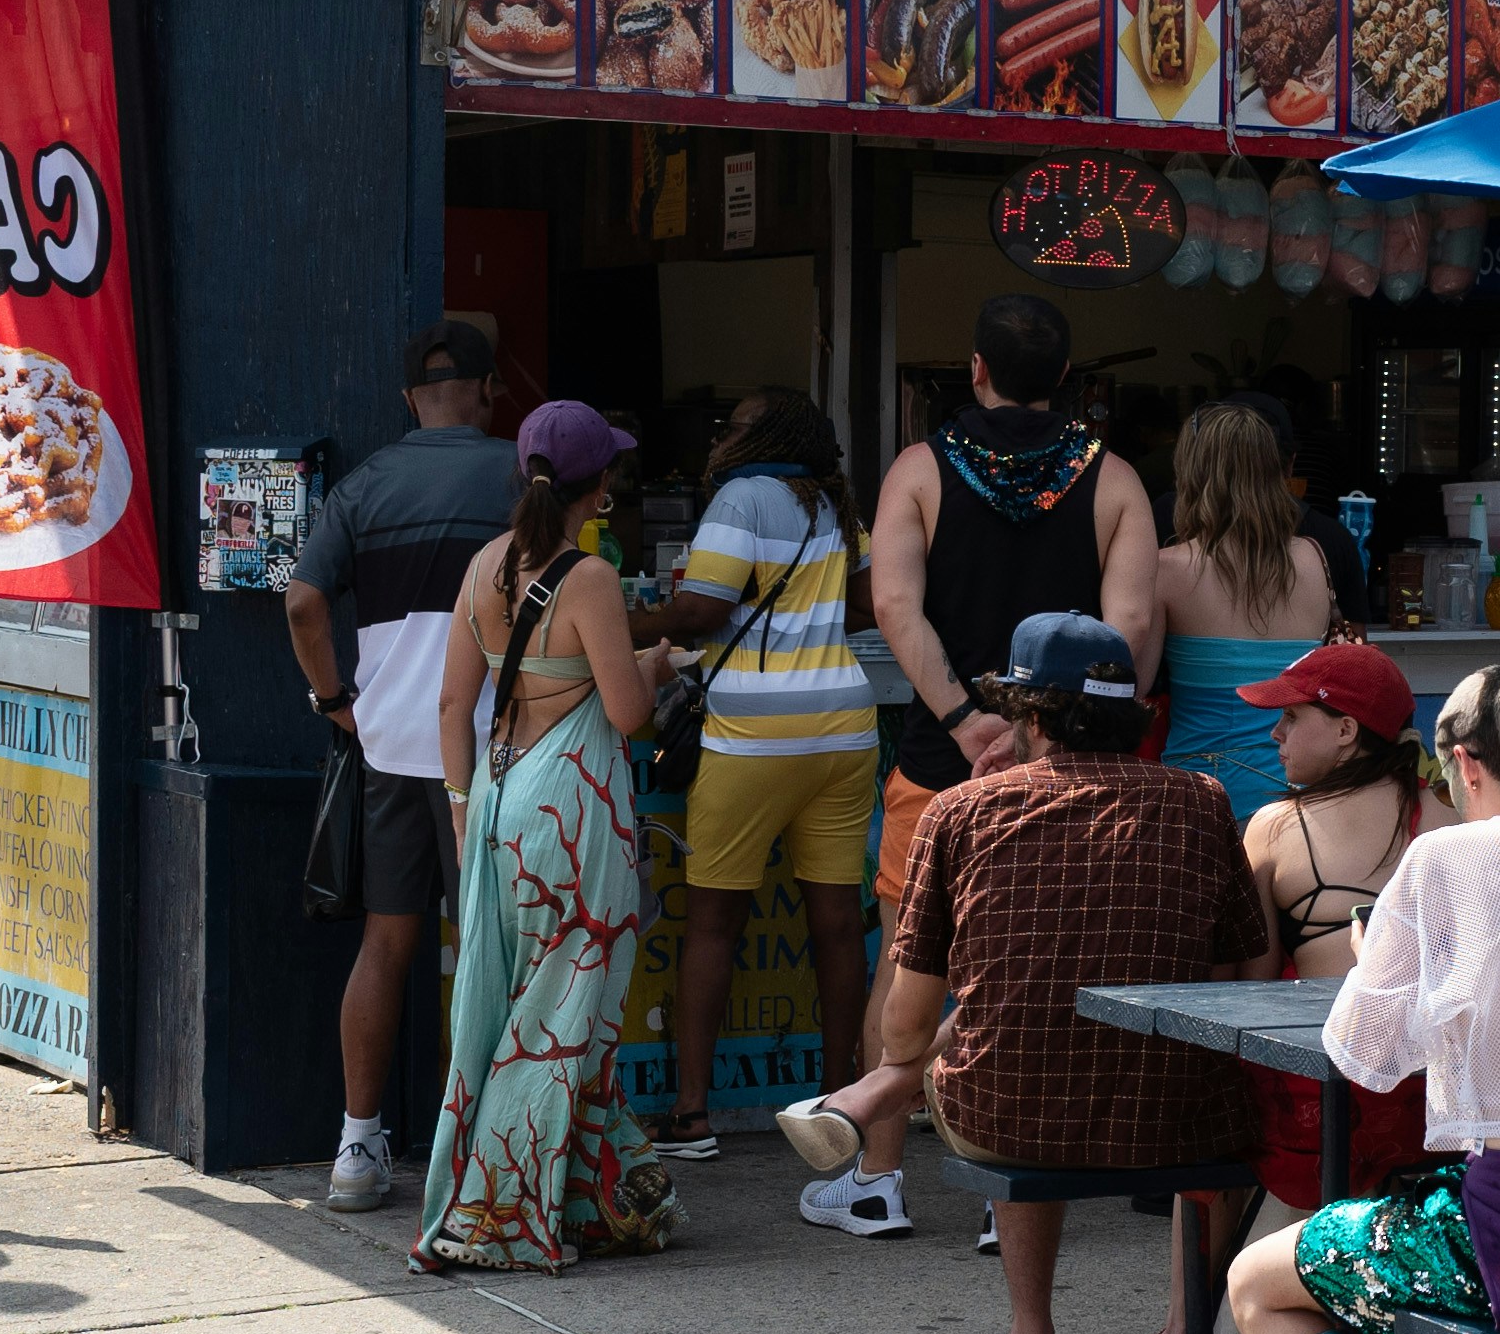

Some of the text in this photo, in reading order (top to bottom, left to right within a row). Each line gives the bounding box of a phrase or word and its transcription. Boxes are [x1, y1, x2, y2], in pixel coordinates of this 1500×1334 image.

[1002, 159, 1173, 234] HOT PIZZA
[266, 477, 294, 489] MUTZ
[266, 497, 294, 510] TRES
